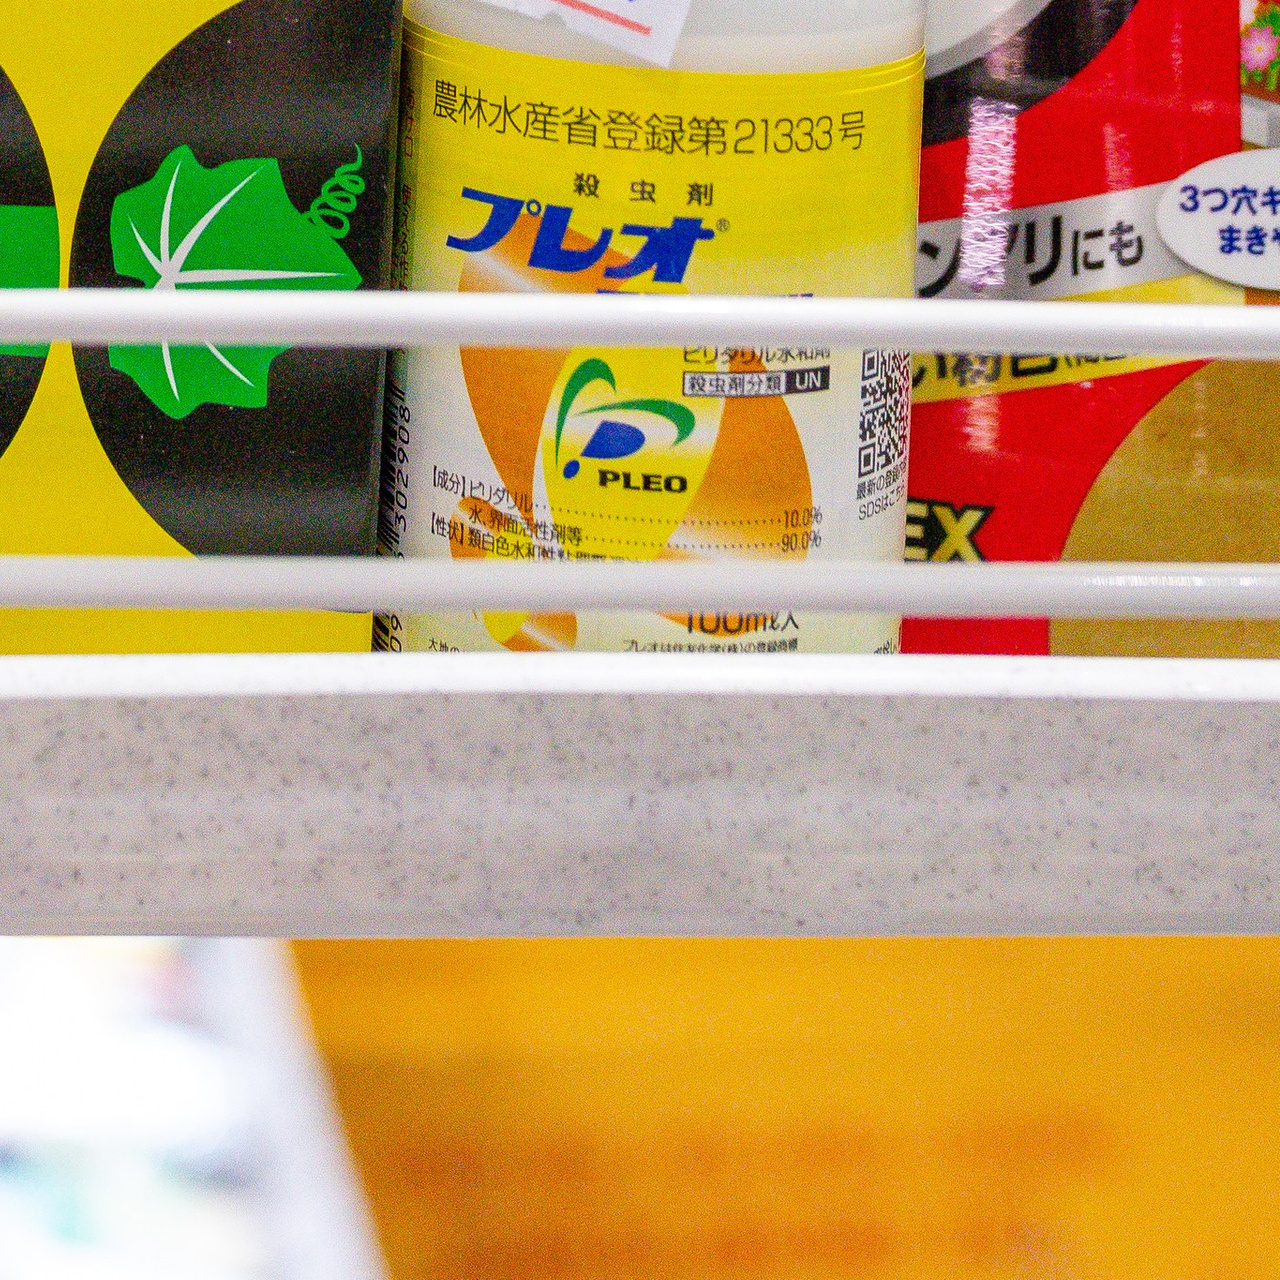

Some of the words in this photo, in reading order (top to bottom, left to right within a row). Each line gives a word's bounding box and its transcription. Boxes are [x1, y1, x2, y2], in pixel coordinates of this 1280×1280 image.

[432, 79, 867, 157] 農林水産省登録第21333号
[572, 171, 714, 208] 殺虫剤
[445, 186, 716, 284] プレオ
[687, 373, 782, 394] 殺虫剤分類
[794, 372, 823, 390] UN
[597, 468, 689, 495] PLEO
